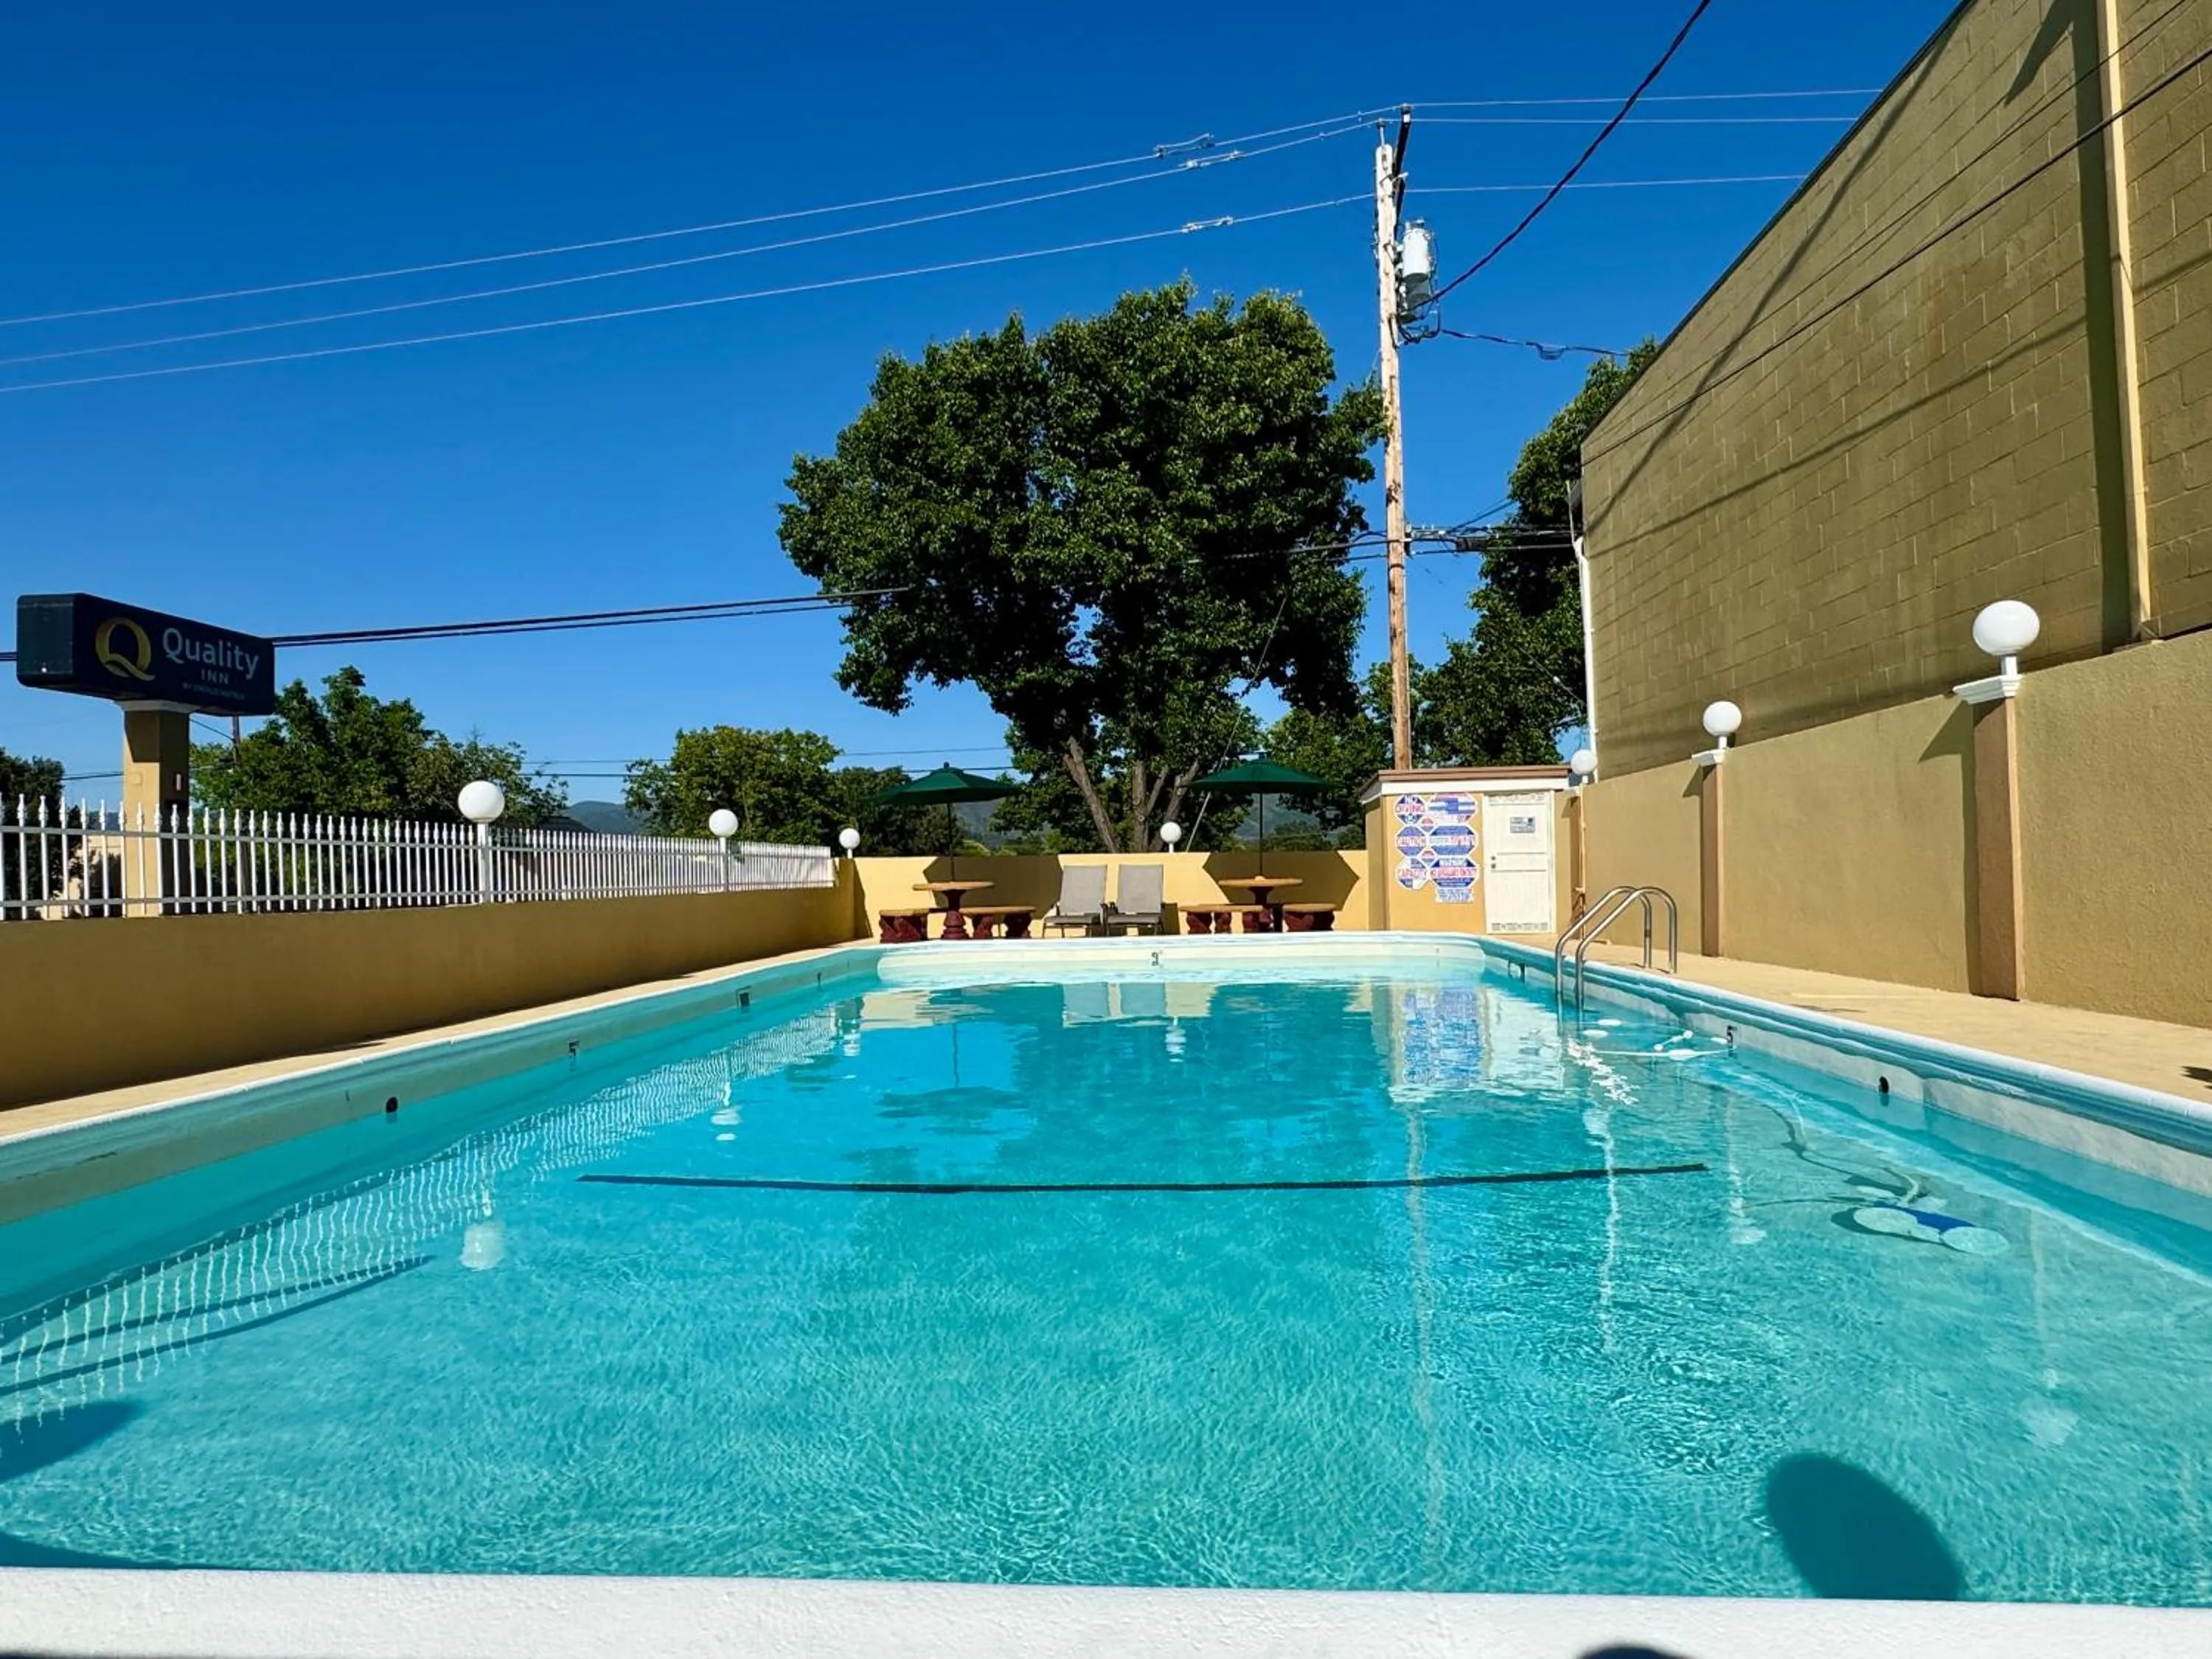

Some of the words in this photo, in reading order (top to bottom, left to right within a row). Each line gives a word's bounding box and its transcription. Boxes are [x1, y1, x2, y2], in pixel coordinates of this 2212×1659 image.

[95, 617, 156, 681] Q
[162, 627, 259, 680] Quality
[201, 668, 229, 685] INN
